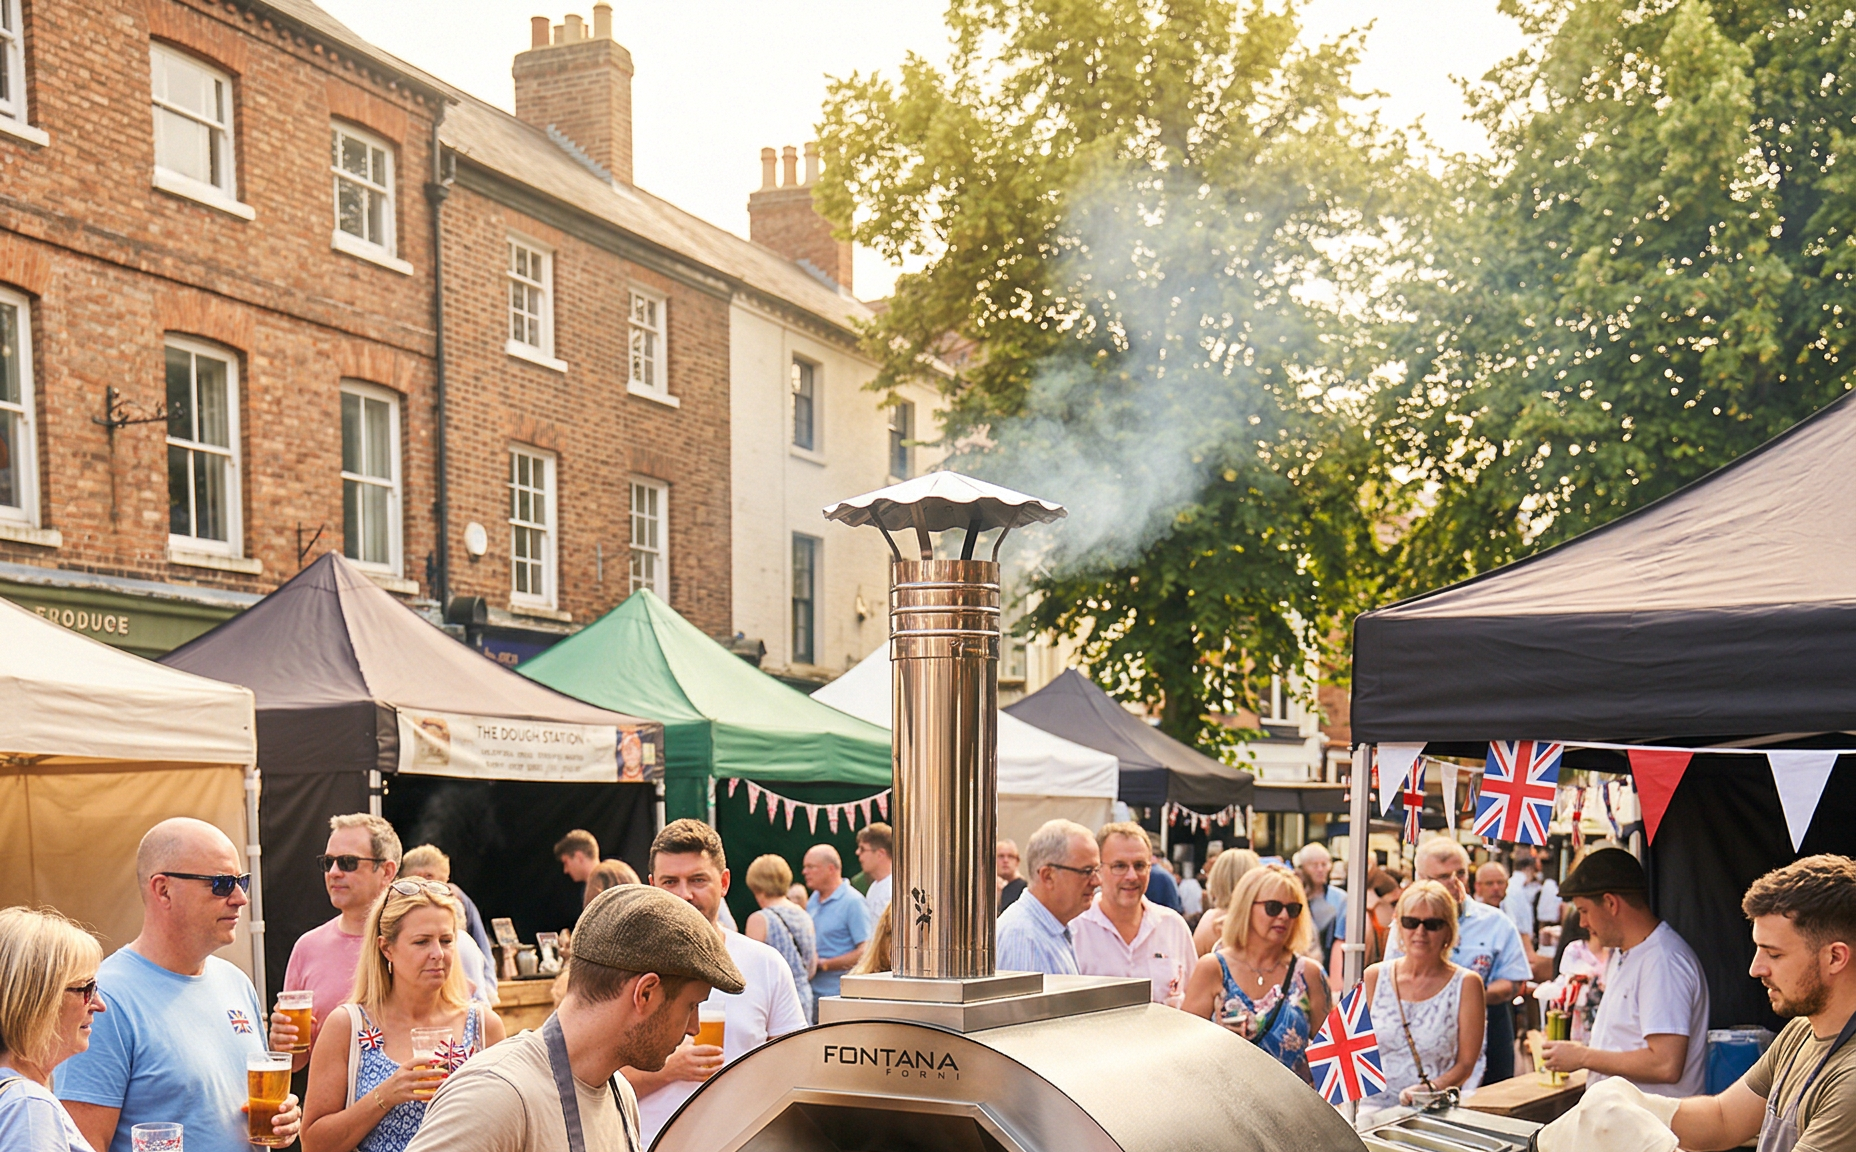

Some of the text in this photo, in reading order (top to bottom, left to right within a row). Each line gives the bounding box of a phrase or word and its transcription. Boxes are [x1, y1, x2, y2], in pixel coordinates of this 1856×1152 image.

[477, 725, 584, 745] THE DOUGH STATION
[824, 1045, 959, 1071] FONTANA
[886, 1068, 960, 1081] FORNI
